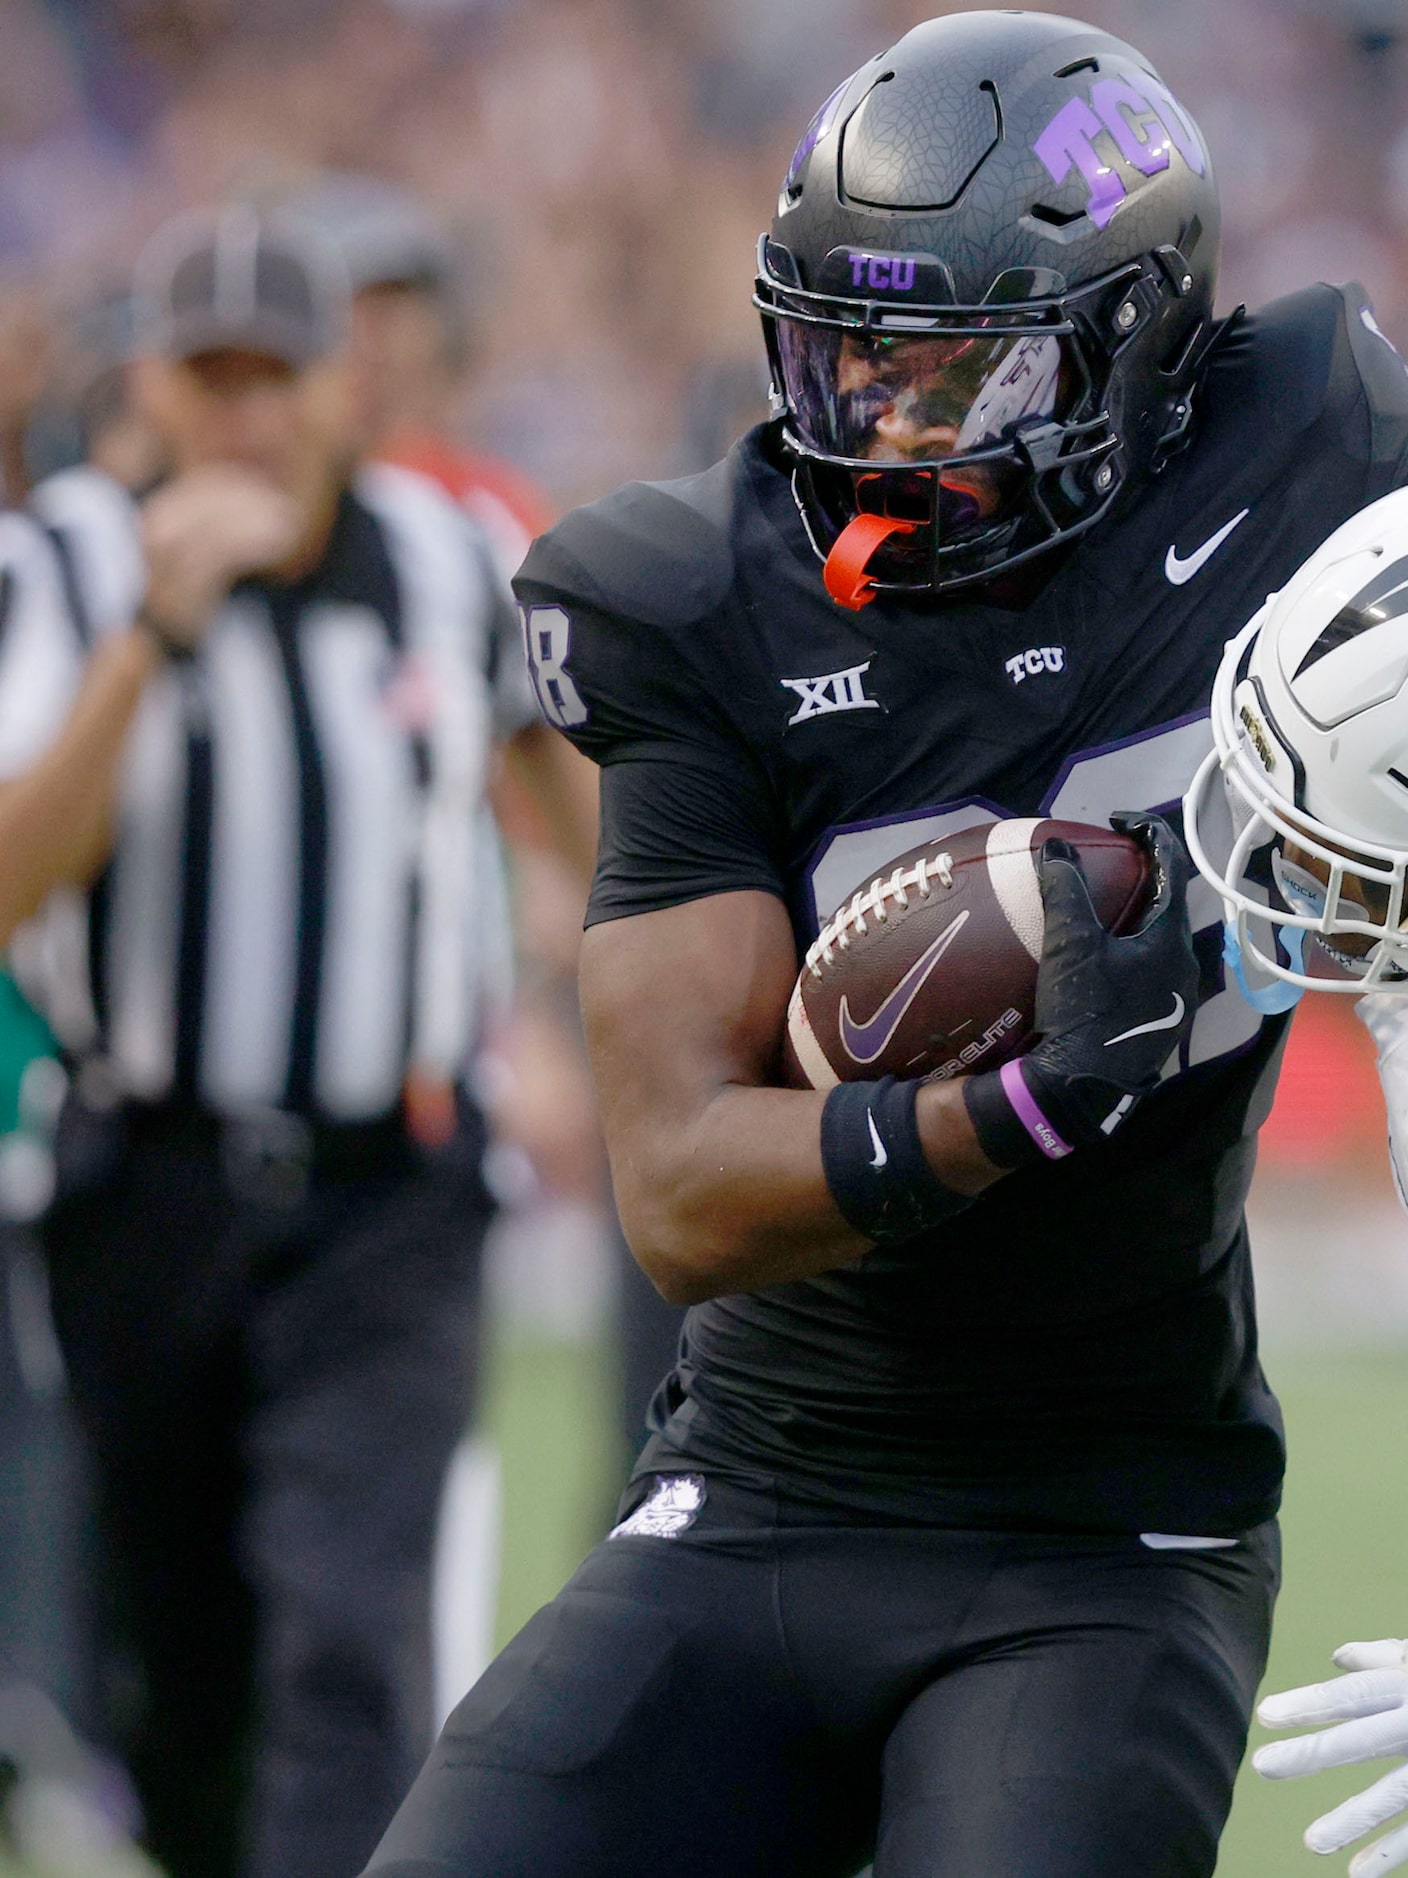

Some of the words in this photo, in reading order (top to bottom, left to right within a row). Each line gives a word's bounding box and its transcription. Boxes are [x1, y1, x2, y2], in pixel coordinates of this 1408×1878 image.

[848, 254, 915, 290] TCU
[517, 603, 588, 730] 8
[1004, 646, 1065, 686] TCU
[781, 660, 880, 726] XII
[959, 1007, 1023, 1065] ELITE
[1034, 1122, 1057, 1149] Boys
